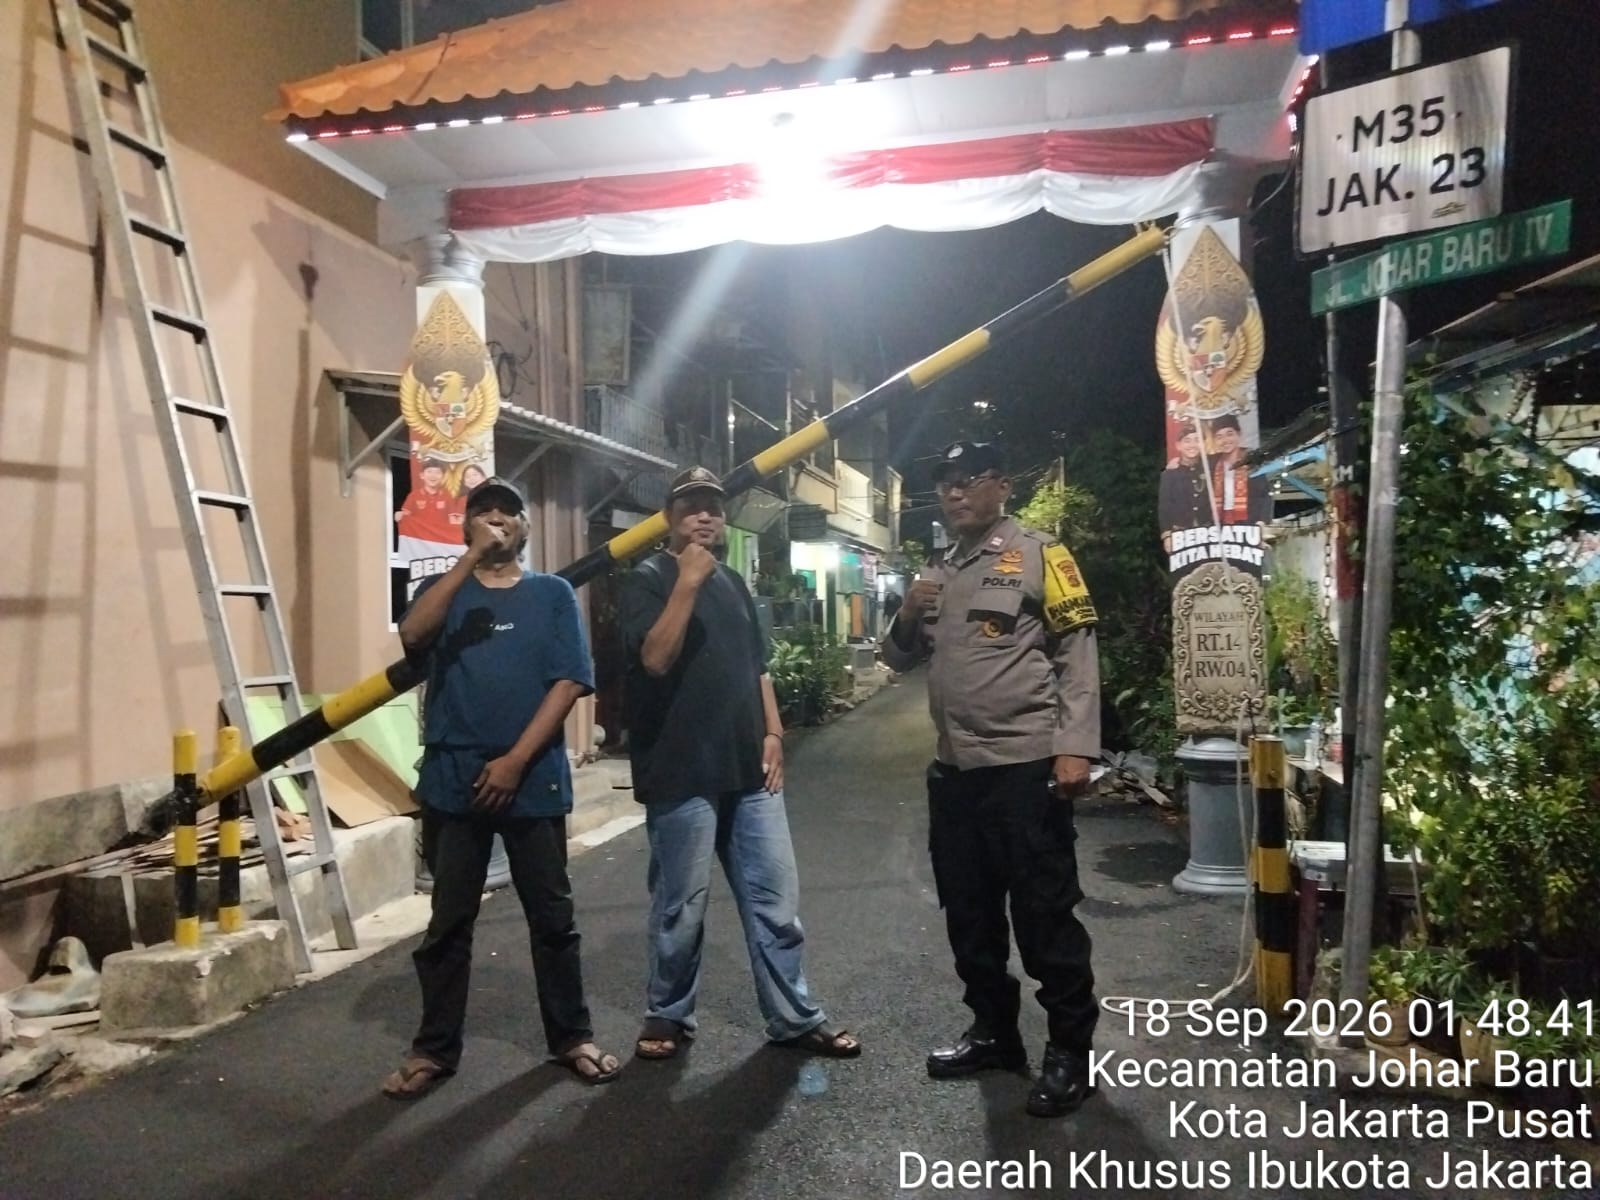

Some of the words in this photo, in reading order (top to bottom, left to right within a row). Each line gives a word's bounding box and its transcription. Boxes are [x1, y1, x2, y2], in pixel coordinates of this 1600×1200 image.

[1352, 97, 1445, 153] M35
[1316, 164, 1415, 217] JAK.
[1429, 147, 1487, 195] 23
[1361, 243, 1432, 296] JOHAR
[1441, 224, 1512, 274] BARU
[1525, 213, 1554, 257] IV
[1171, 525, 1261, 552] BERSATU
[409, 557, 459, 580] BERS
[1169, 546, 1208, 572] KITA
[1209, 544, 1265, 566] HEBAT
[982, 577, 1022, 588] POLRI
[1193, 611, 1245, 623] WILAYAH
[1195, 660, 1247, 678] RW.04
